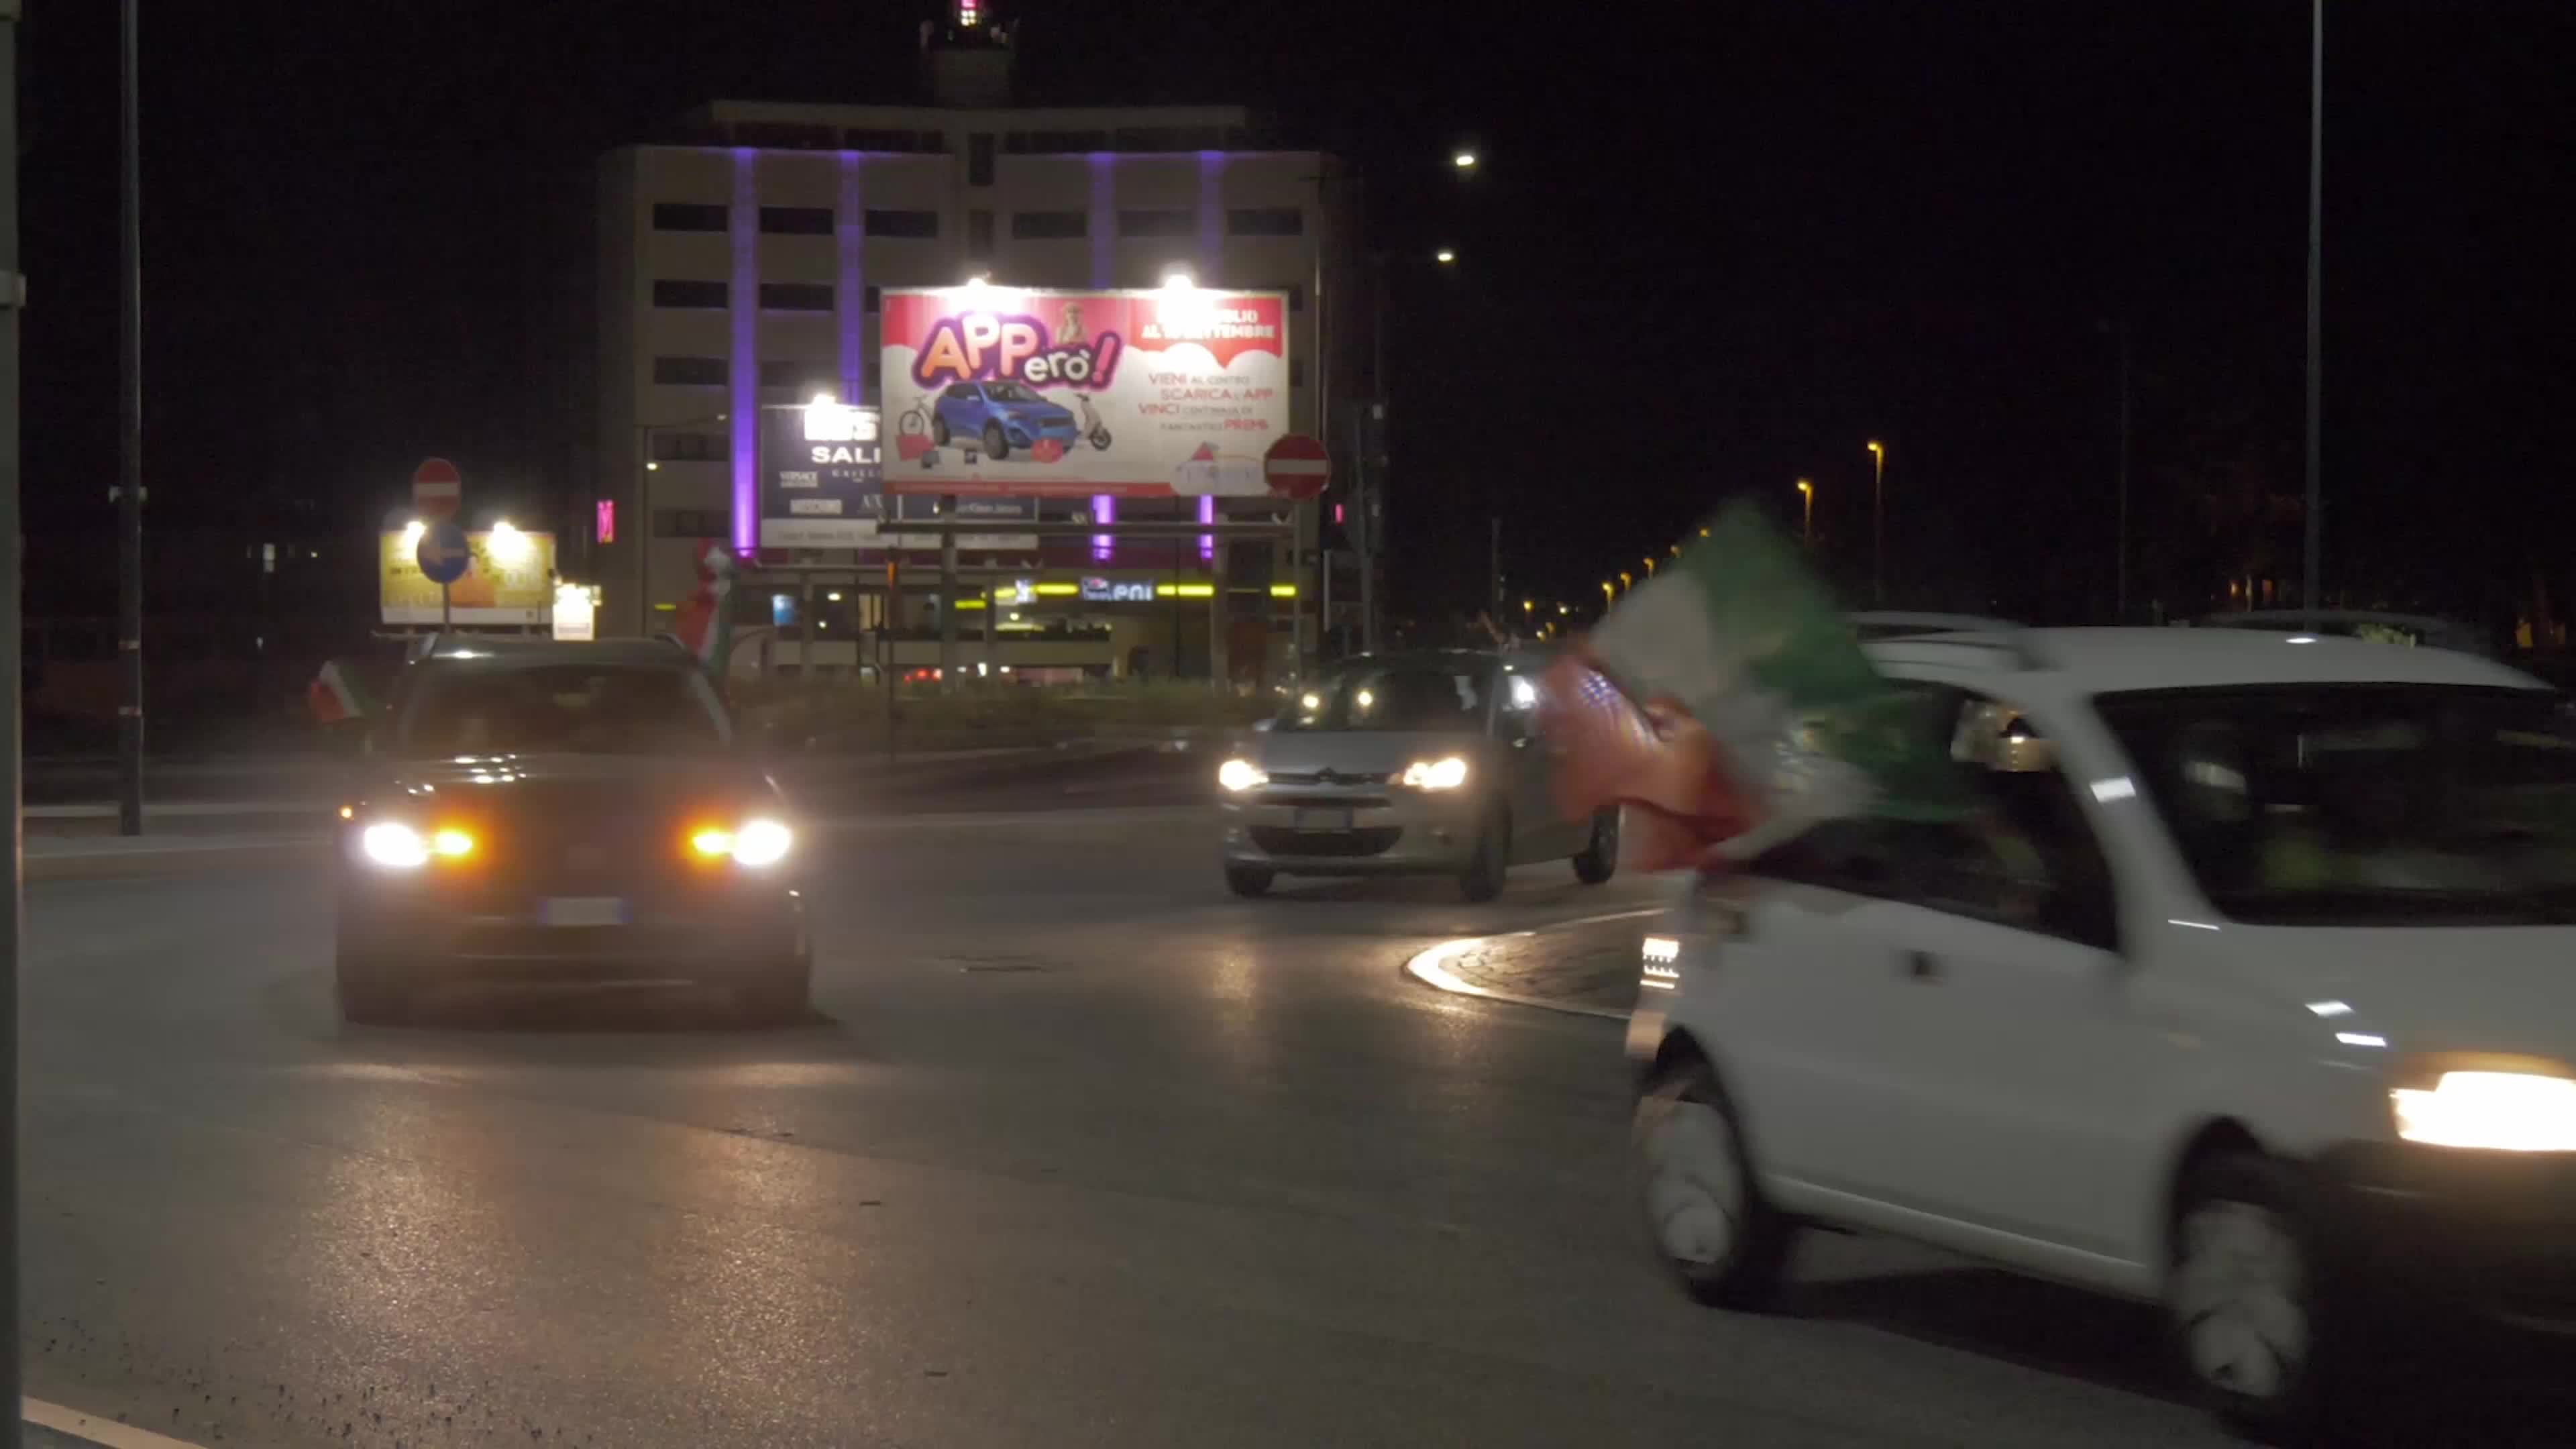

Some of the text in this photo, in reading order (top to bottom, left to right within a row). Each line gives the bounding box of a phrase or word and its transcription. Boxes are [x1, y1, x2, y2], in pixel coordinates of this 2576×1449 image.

[1148, 373, 1187, 384] VIENI
[1161, 388, 1231, 400] SCARICA
[1138, 402, 1181, 414] VINCI
